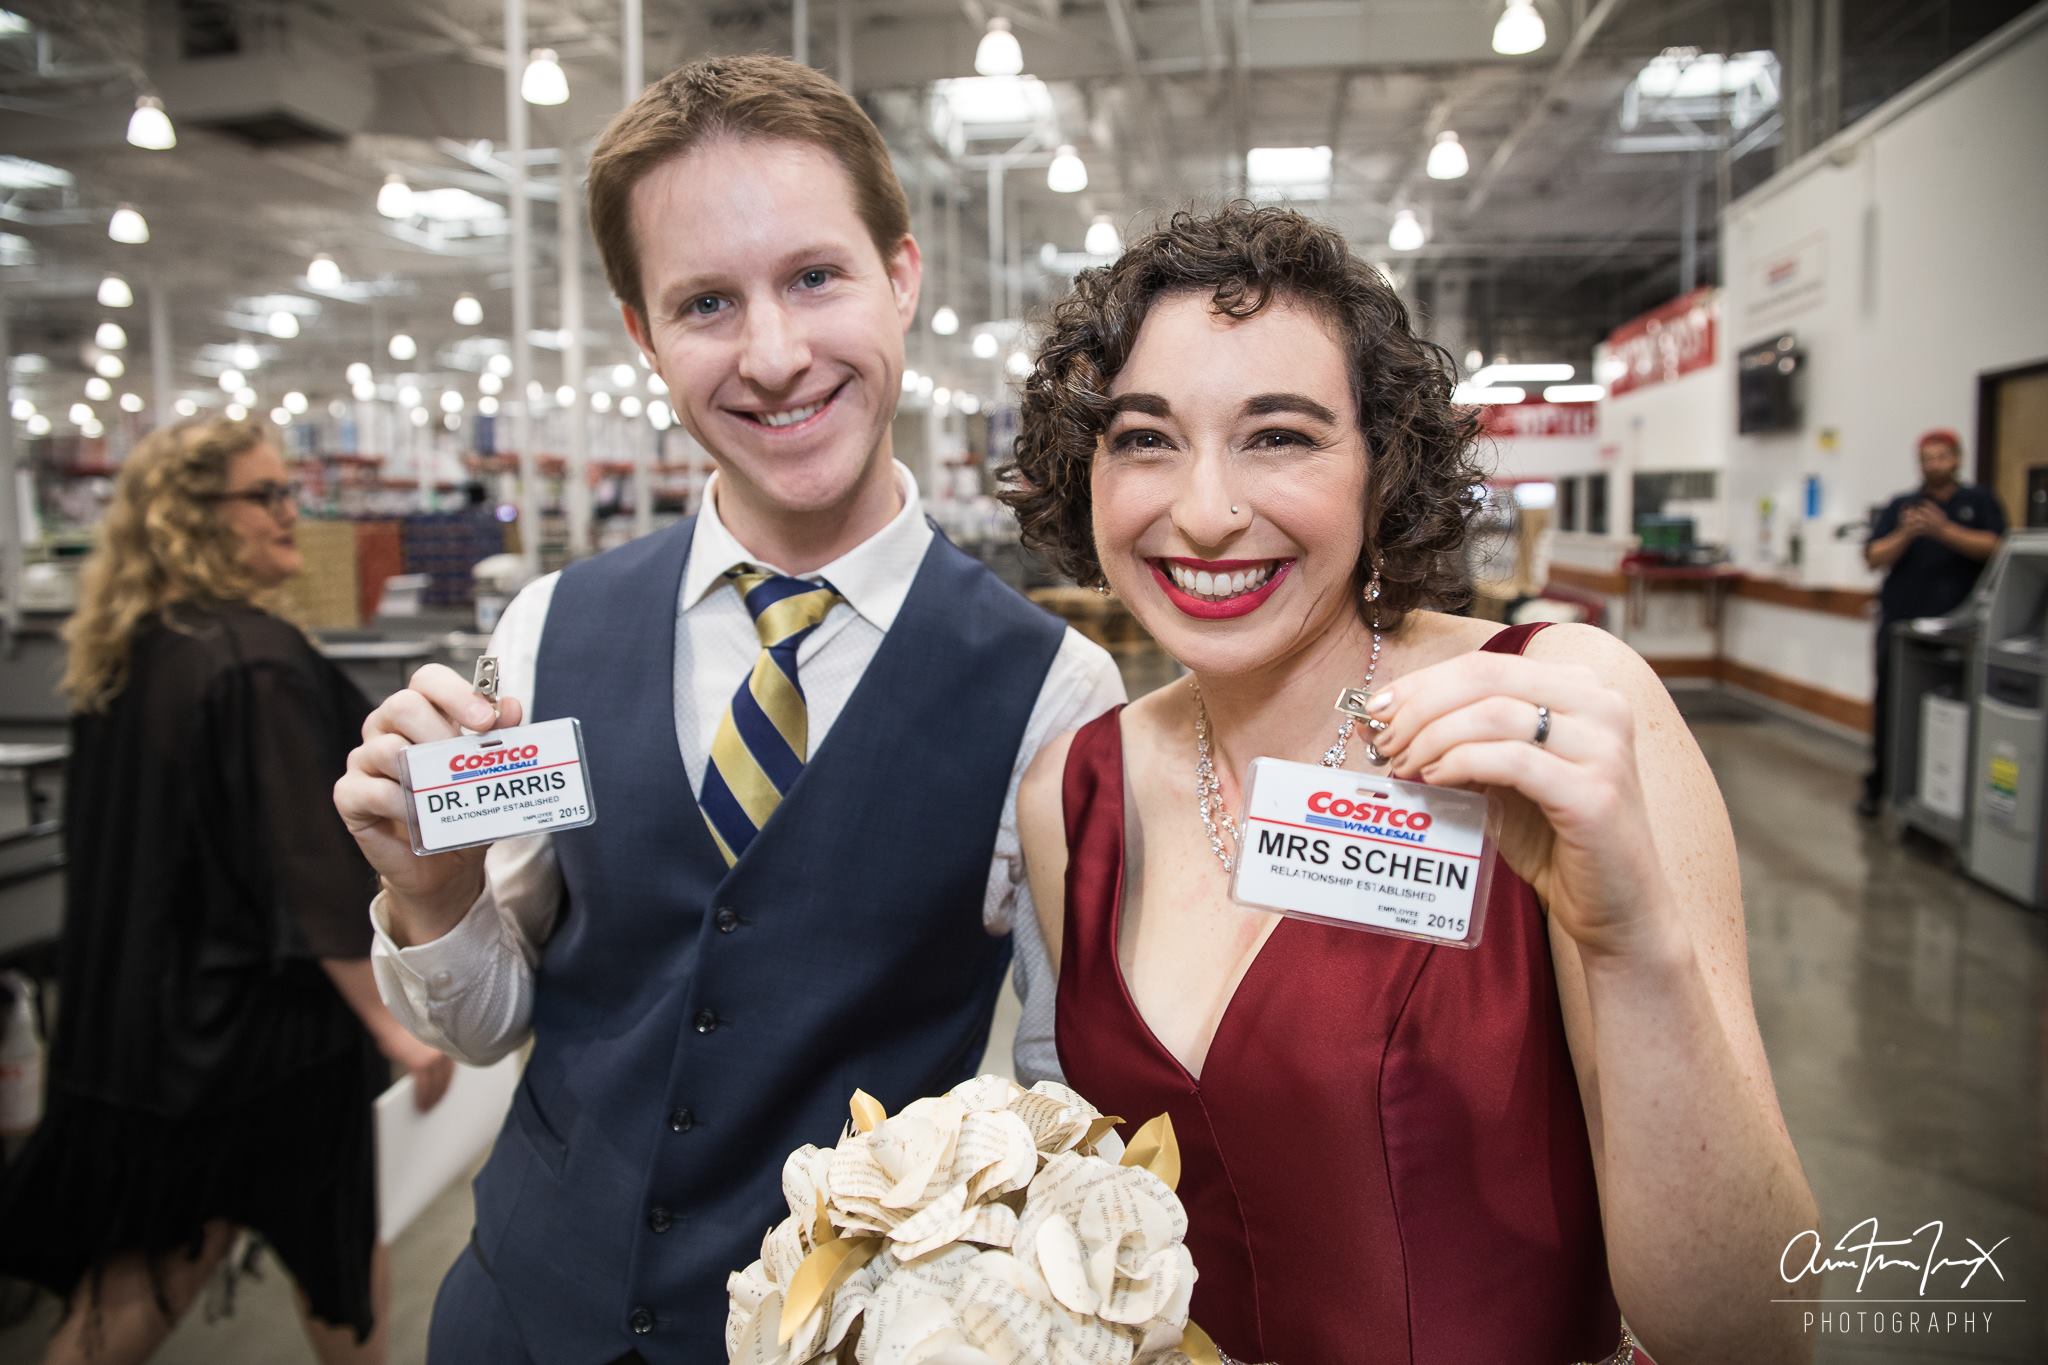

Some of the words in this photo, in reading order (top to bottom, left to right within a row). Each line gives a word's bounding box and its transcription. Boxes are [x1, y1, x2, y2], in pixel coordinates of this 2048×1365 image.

[449, 744, 539, 772] COSTCO
[478, 759, 538, 776] WHOLESALE
[427, 790, 470, 814] DR.
[476, 771, 566, 804] PARRIS
[440, 806, 501, 824] RELATIONSHIP
[503, 795, 560, 812] ESTABLISHED
[523, 811, 553, 821] EMPLOYEE
[559, 805, 586, 819] 2015
[1307, 791, 1433, 832] COSTCO
[1343, 820, 1427, 843] WHOLESALE
[1257, 829, 1330, 865] MRS
[1342, 845, 1469, 890] SCHEIN
[1271, 864, 1354, 887] RELATIONSHIP
[1356, 873, 1436, 903] ESTABLISHED
[1378, 905, 1419, 917] EMPLOYEE
[1427, 913, 1465, 932] 2015
